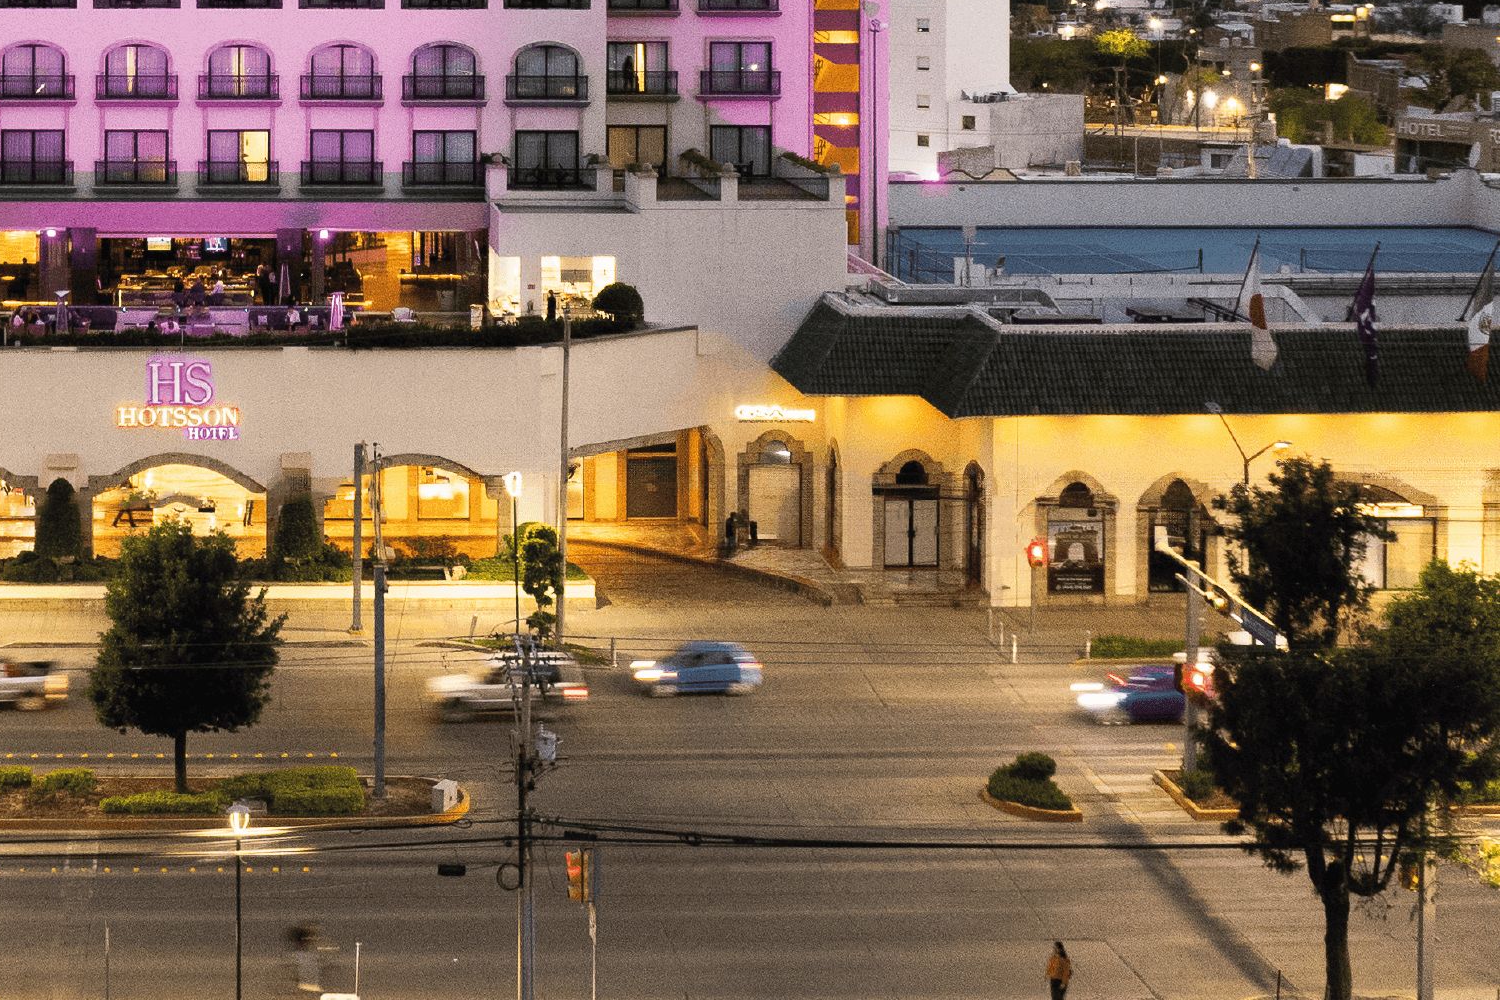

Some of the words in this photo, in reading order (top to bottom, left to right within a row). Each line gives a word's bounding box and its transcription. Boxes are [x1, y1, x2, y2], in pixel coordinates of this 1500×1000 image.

[1398, 121, 1445, 137] HOTEL
[148, 361, 213, 405] HS
[117, 406, 239, 428] HOTSSON
[187, 427, 239, 440] HOTEL
